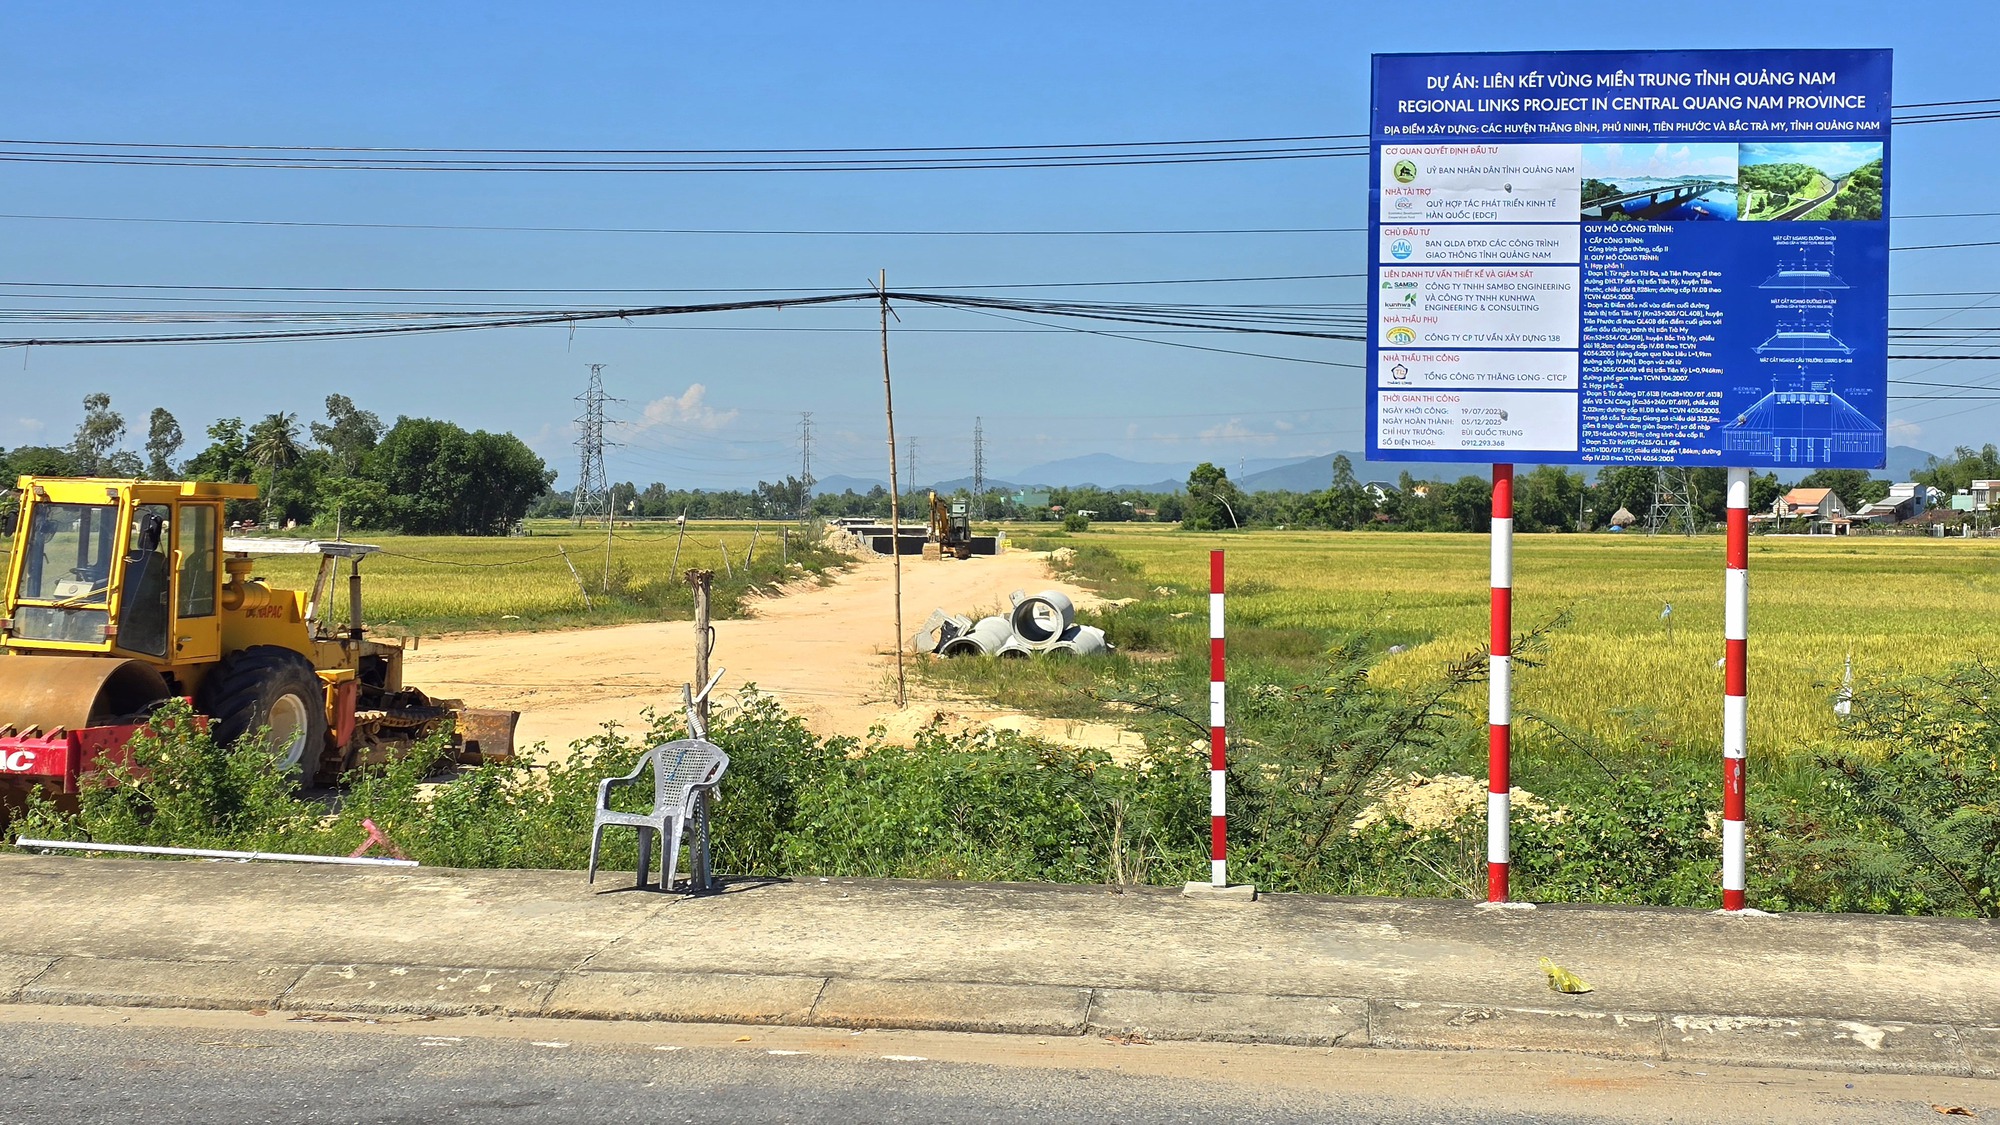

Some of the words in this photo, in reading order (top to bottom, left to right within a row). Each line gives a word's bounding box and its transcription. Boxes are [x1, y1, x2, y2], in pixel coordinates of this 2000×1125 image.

[1427, 76, 1450, 92] DỰ
[1452, 72, 1479, 89] ÁN:
[1483, 72, 1514, 88] LIÊN
[1519, 70, 1544, 88] KẾT
[1547, 71, 1592, 88] VÙNG
[1597, 69, 1634, 87] MIỀN
[1638, 74, 1691, 87] TRUNG
[1694, 70, 1730, 86] TỈNH
[1734, 69, 1794, 87] QUẢNG
[1799, 72, 1835, 85] NAM
[1398, 100, 1474, 113] REGIONAL
[1478, 99, 1519, 112] LINKS
[1524, 98, 1588, 112] PROJECT
[1592, 98, 1607, 111] IN
[1612, 98, 1679, 111] CENTRAL
[1683, 97, 1742, 111] QUANG
[1747, 96, 1783, 109] NAM
[1788, 96, 1866, 109] PROVINCE
[1384, 126, 1400, 136] ĐỊA
[1402, 122, 1425, 134] ĐIỂM
[1427, 123, 1446, 134] XÂY
[1448, 125, 1479, 135] DỰNG:
[1481, 122, 1502, 133] CÁC
[1504, 122, 1536, 135] HUYỆN
[1538, 122, 1572, 133] THĂNG
[1574, 122, 1600, 134] BÌNH,
[1602, 122, 1621, 132] PHÚ
[1624, 124, 1651, 133] NINH,
[1653, 121, 1674, 132] TIÊN
[1676, 121, 1711, 131] PHƯỚC
[1713, 121, 1727, 131] VÀ
[1729, 120, 1748, 131] BẮC
[1750, 120, 1769, 131] TRÀ
[1771, 122, 1788, 132] MY,
[1790, 120, 1813, 130] TỈNH
[1815, 120, 1854, 131] QUẢNG
[1856, 122, 1880, 130] NAM
[1450, 148, 1468, 156] ĐỊNH
[1470, 145, 1486, 154] ĐẦU
[1457, 165, 1481, 174] NHÂN
[1483, 165, 1500, 174] DÂN
[1502, 165, 1520, 174] TỈNH
[1522, 165, 1553, 174] QUẢNG
[1385, 187, 1402, 195] NHÀ
[1415, 189, 1431, 197] TRỢ
[1445, 201, 1462, 209] HỢP
[1464, 199, 1479, 207] TÁC
[1481, 199, 1501, 207] PHÁT
[1503, 198, 1524, 207] TRIỂN
[1548, 198, 1556, 207] TẾ
[1445, 210, 1470, 219] QUỐC
[1402, 227, 1418, 236] ĐẦU
[1604, 224, 1618, 232] MÔ
[1620, 224, 1646, 232] CÔNG
[1648, 224, 1674, 232] TRÌNH:
[1489, 239, 1506, 247] CÁC
[1508, 239, 1534, 247] CÔNG
[1536, 239, 1559, 247] TRÌNH
[1448, 250, 1477, 258] THÔNG
[1479, 250, 1497, 258] TỈNH
[1499, 250, 1530, 259] QUẢNG
[1436, 269, 1452, 277] VẤN
[1454, 269, 1473, 277] THIẾT
[1475, 269, 1483, 277] KẾ
[1425, 282, 1450, 290] CÔNG
[1425, 293, 1436, 301] VÀ
[1438, 293, 1463, 301] CÔNG
[1424, 333, 1450, 341] CÔNG
[1486, 333, 1503, 341] VẤN
[1505, 333, 1520, 341] XÂY
[1383, 354, 1400, 362] NHÀ
[1435, 354, 1460, 362] CÔNG
[1425, 372, 1448, 380] TỔNG
[1382, 427, 1395, 435] CHỈ
[1474, 427, 1497, 436] QUỐC
[1382, 437, 1392, 445] SỐ
[0, 750, 36, 770] C
